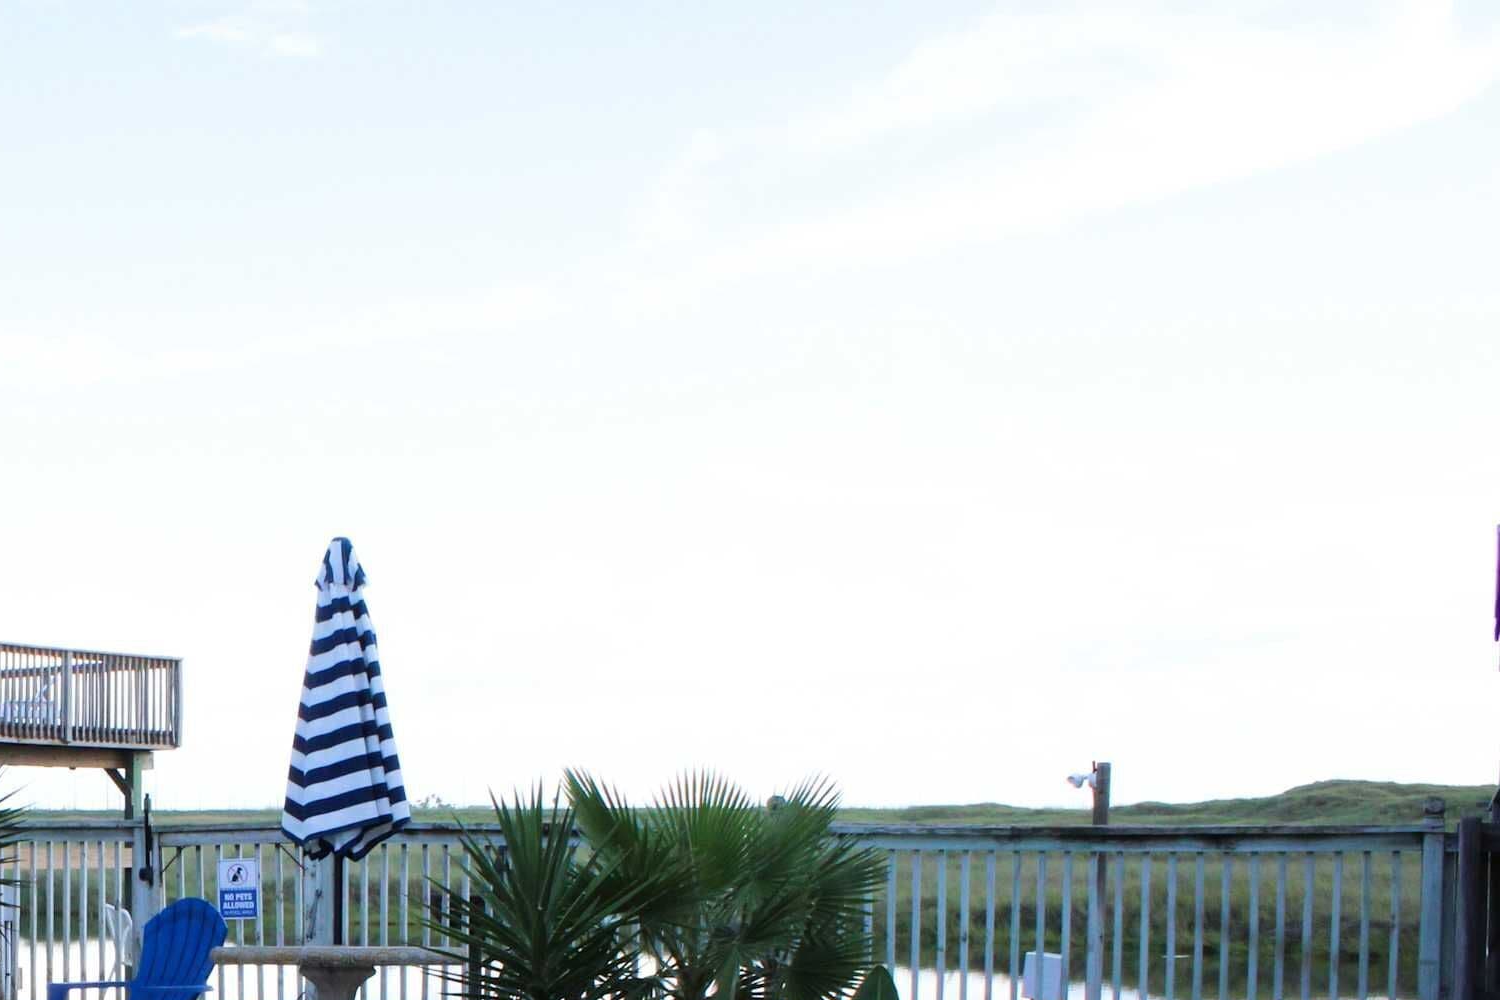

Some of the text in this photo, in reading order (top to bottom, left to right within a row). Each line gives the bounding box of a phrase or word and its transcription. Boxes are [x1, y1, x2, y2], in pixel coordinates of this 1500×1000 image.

[224, 893, 253, 901] NO PETS
[222, 901, 255, 909] ALLOWED
